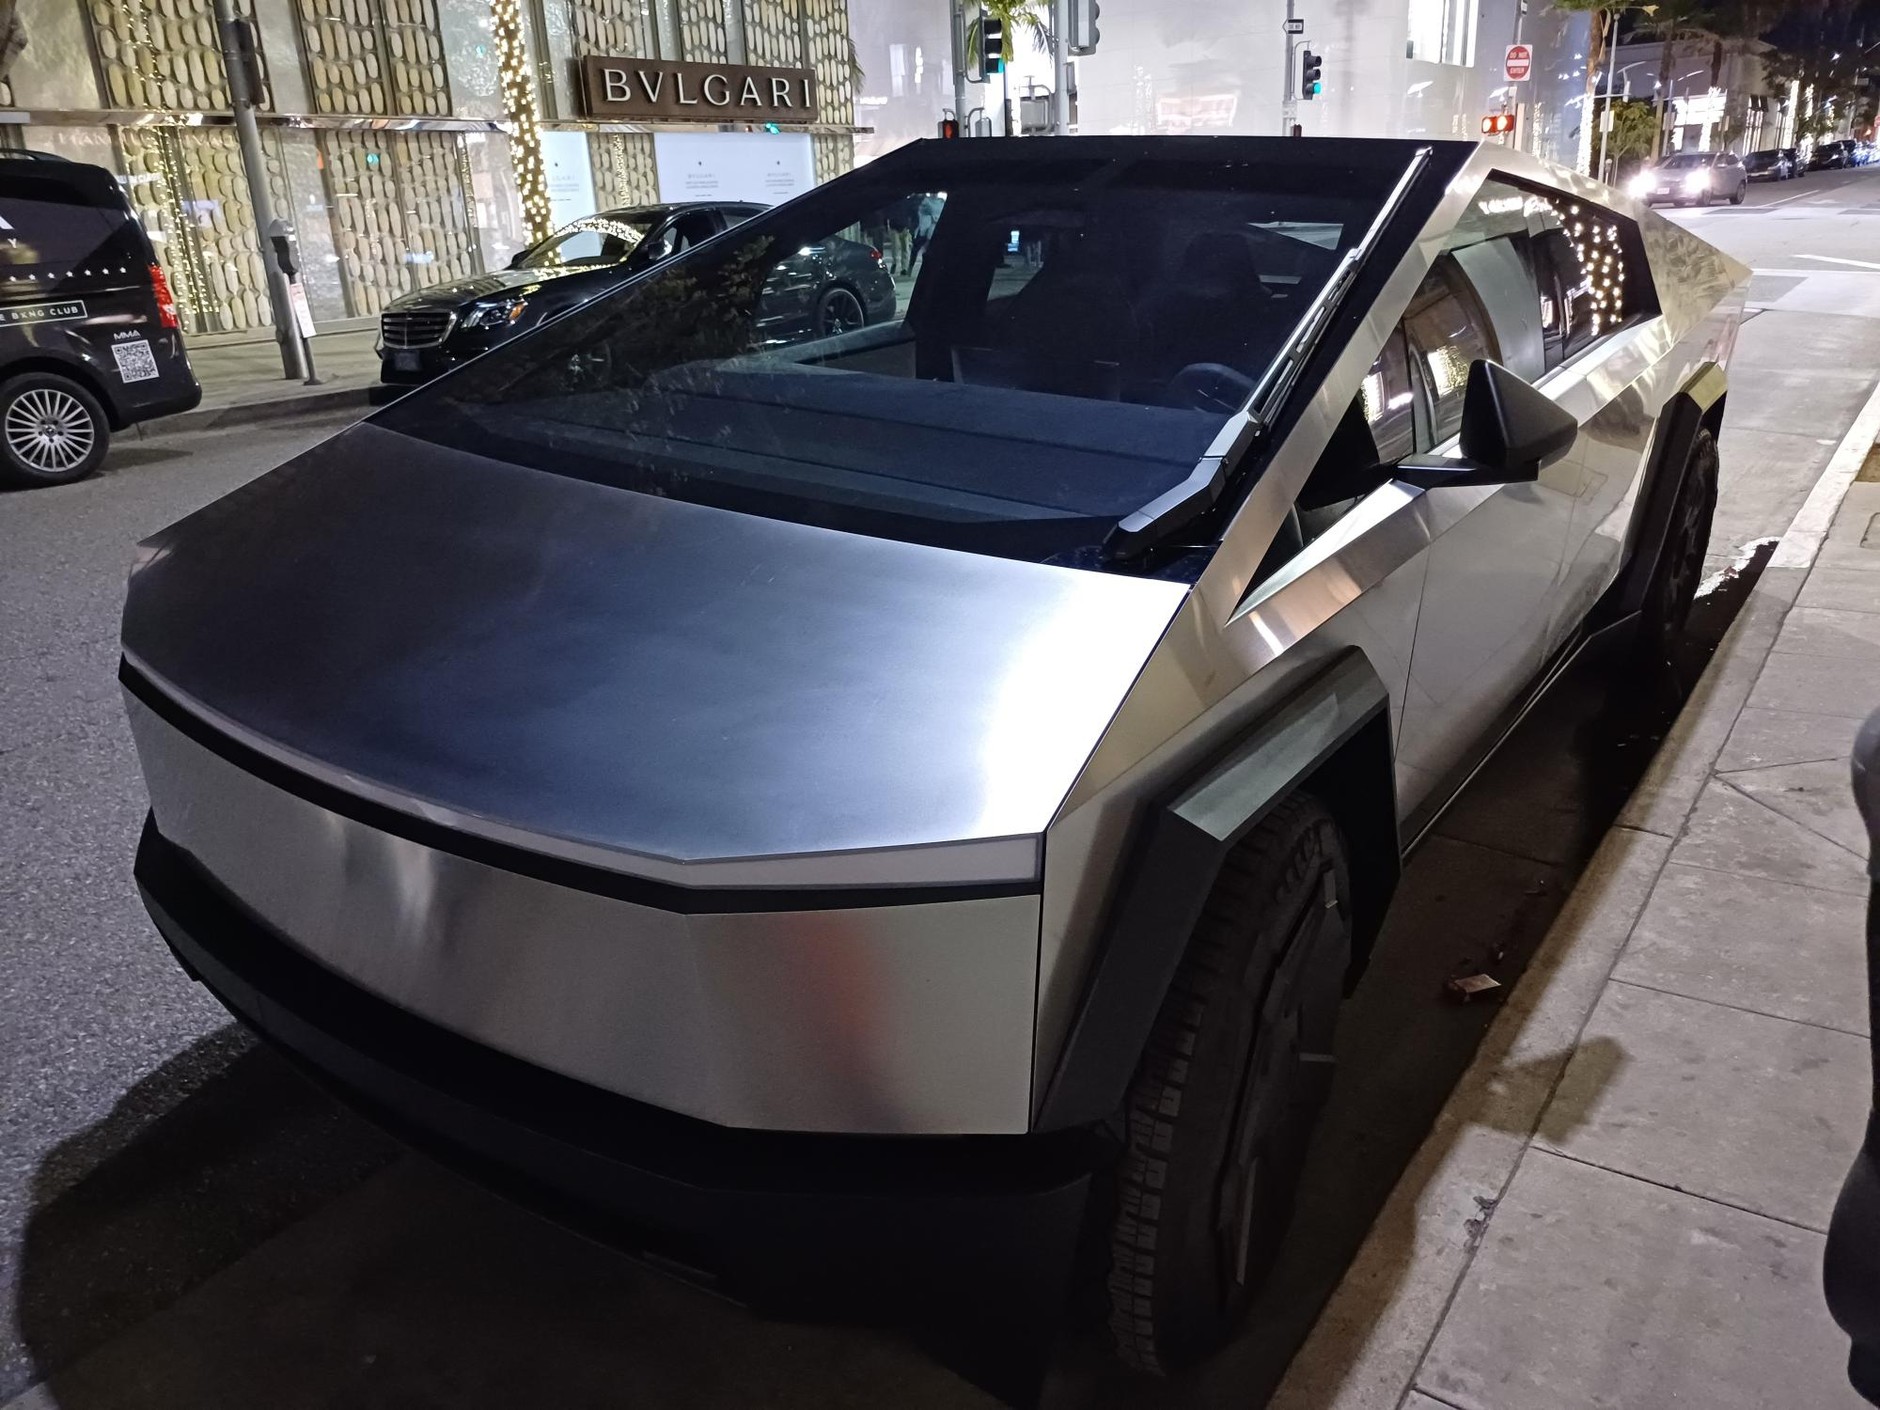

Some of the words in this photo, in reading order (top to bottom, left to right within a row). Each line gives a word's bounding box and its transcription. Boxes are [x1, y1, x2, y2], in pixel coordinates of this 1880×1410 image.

[604, 68, 811, 108] BVLGARI
[11, 309, 45, 320] BXNG
[49, 306, 79, 316] CLUB
[113, 329, 141, 340] MMA
